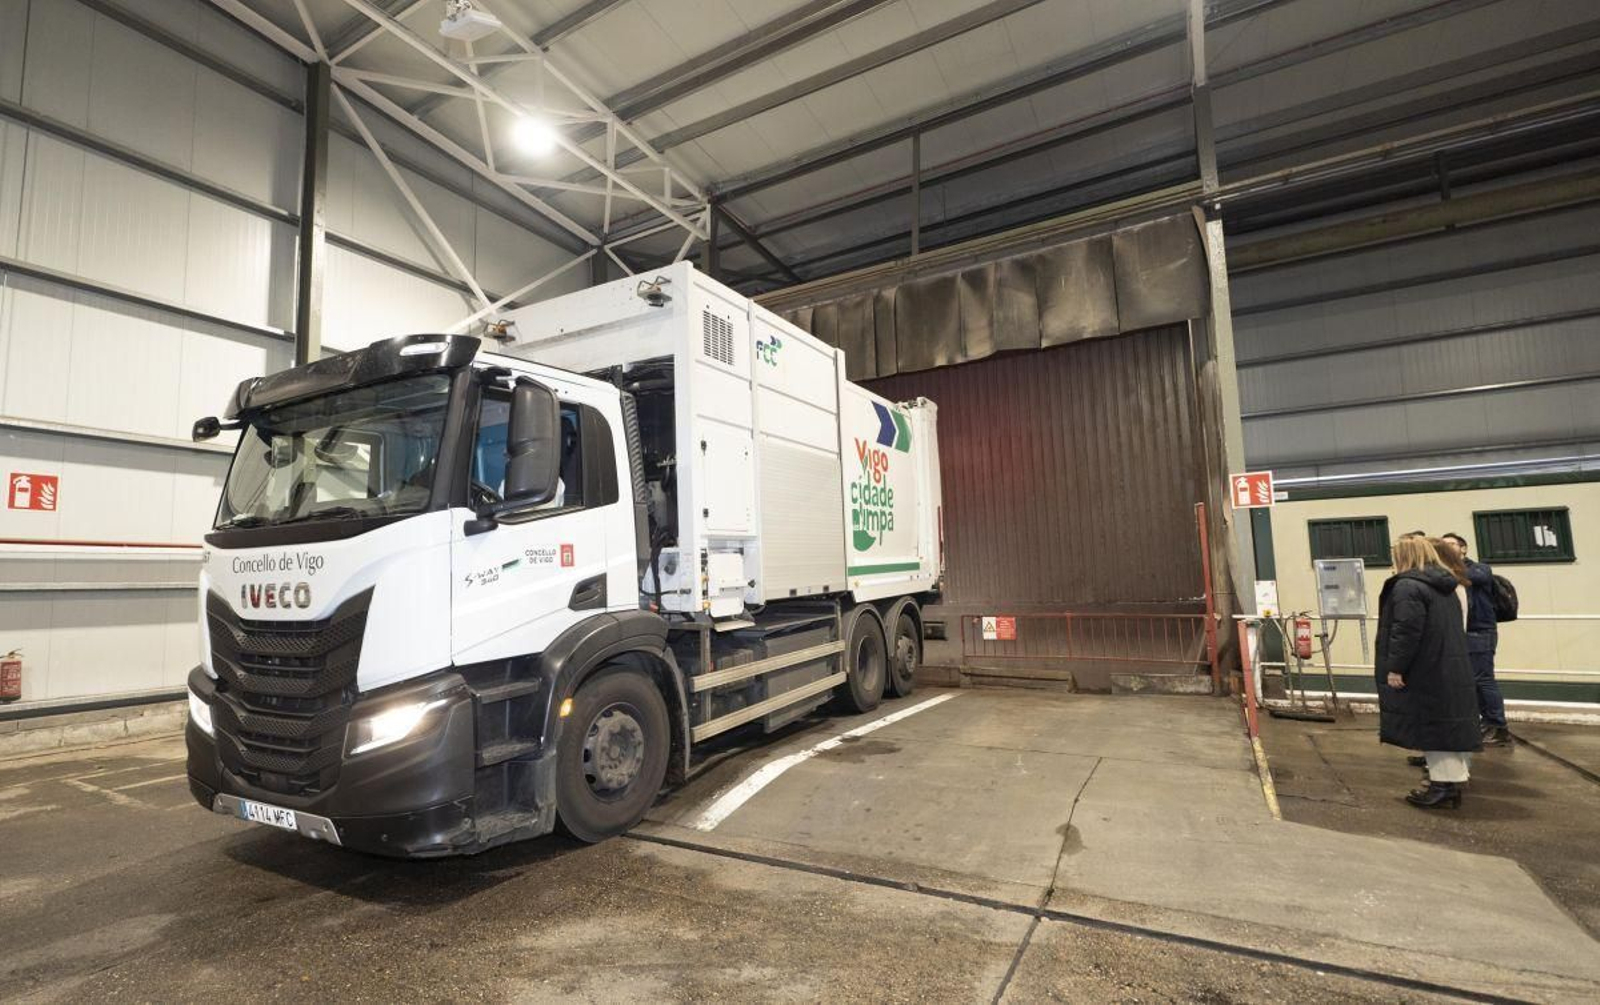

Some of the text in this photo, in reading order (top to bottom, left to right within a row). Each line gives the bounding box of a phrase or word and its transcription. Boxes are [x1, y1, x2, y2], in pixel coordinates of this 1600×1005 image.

[756, 340, 777, 367] FCC
[854, 437, 889, 483] Vigo
[851, 470, 894, 508] cidade
[232, 551, 324, 576] Concello de Vigo
[241, 582, 311, 609] IVECO
